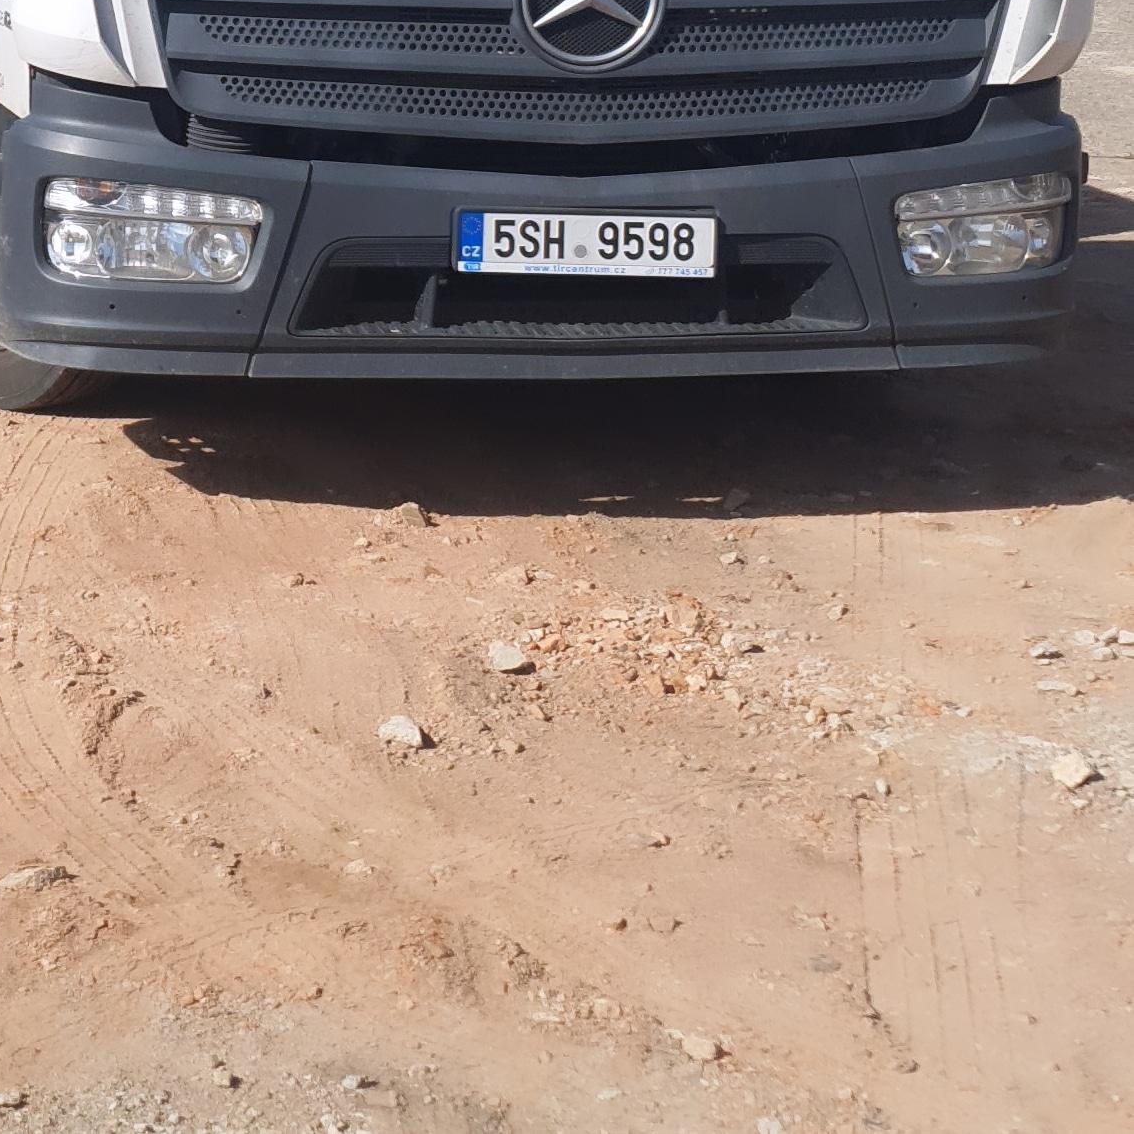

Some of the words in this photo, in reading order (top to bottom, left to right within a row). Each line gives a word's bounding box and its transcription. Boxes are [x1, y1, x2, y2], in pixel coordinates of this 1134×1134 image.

[461, 245, 481, 258] CZ
[493, 219, 565, 260] 5SH
[597, 221, 695, 262] 9598
